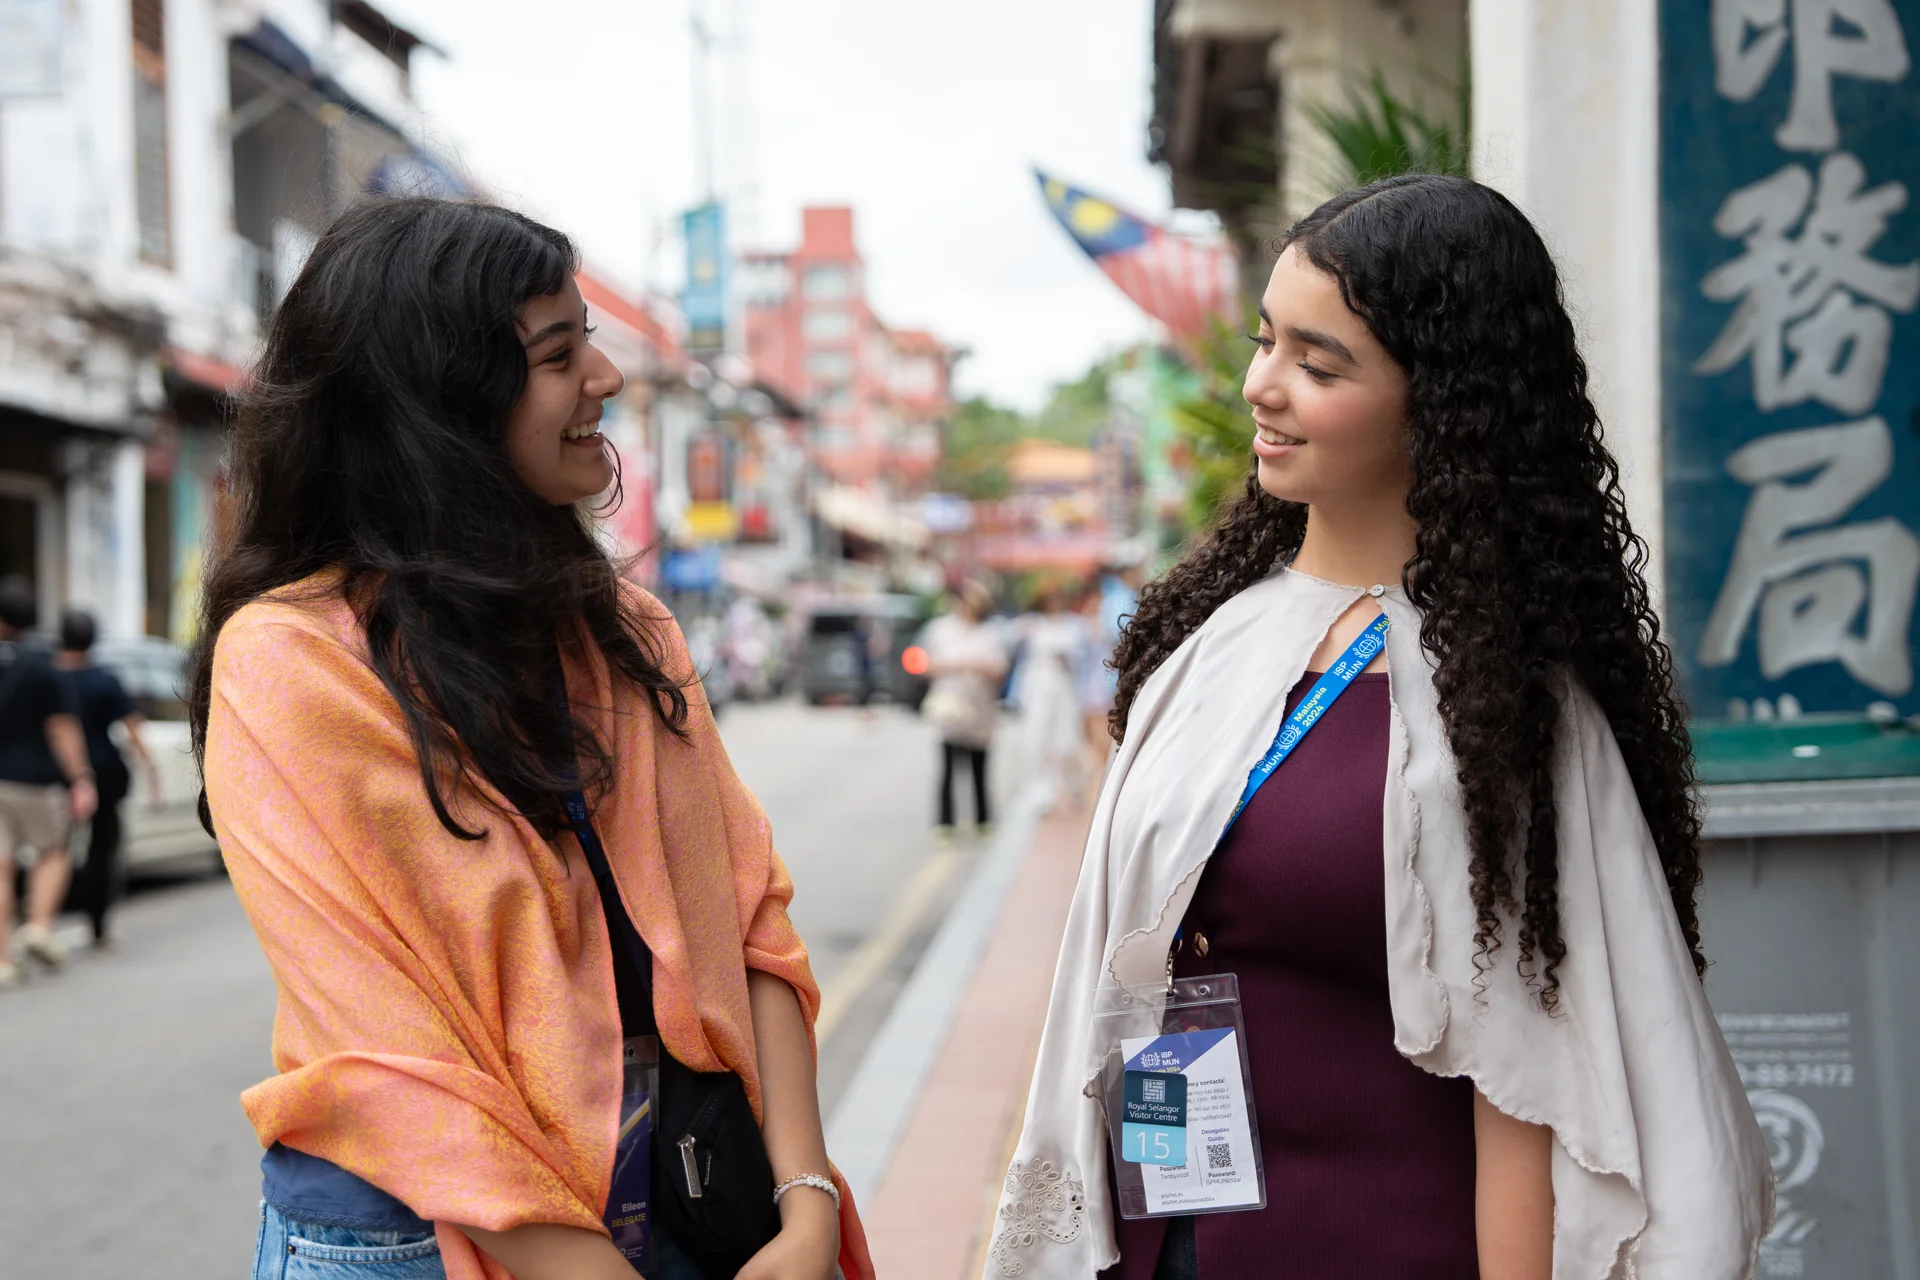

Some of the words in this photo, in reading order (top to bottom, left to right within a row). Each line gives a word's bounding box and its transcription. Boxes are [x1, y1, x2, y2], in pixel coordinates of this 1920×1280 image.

[1342, 660, 1363, 681] MUN
[1294, 687, 1327, 722] Malaysia
[1302, 705, 1324, 727] 2024
[1262, 752, 1283, 774] MUN
[1162, 1058, 1180, 1066] MUN
[1128, 1101, 1147, 1111] Royal
[1149, 1103, 1180, 1114] Selangor
[1130, 1110, 1152, 1119] Visitor
[1153, 1112, 1178, 1122] Centre
[1201, 1127, 1230, 1135] Delegates
[1137, 1131, 1170, 1160] 15
[622, 1201, 646, 1212] Eileen
[611, 1212, 646, 1228] DELEGATE
